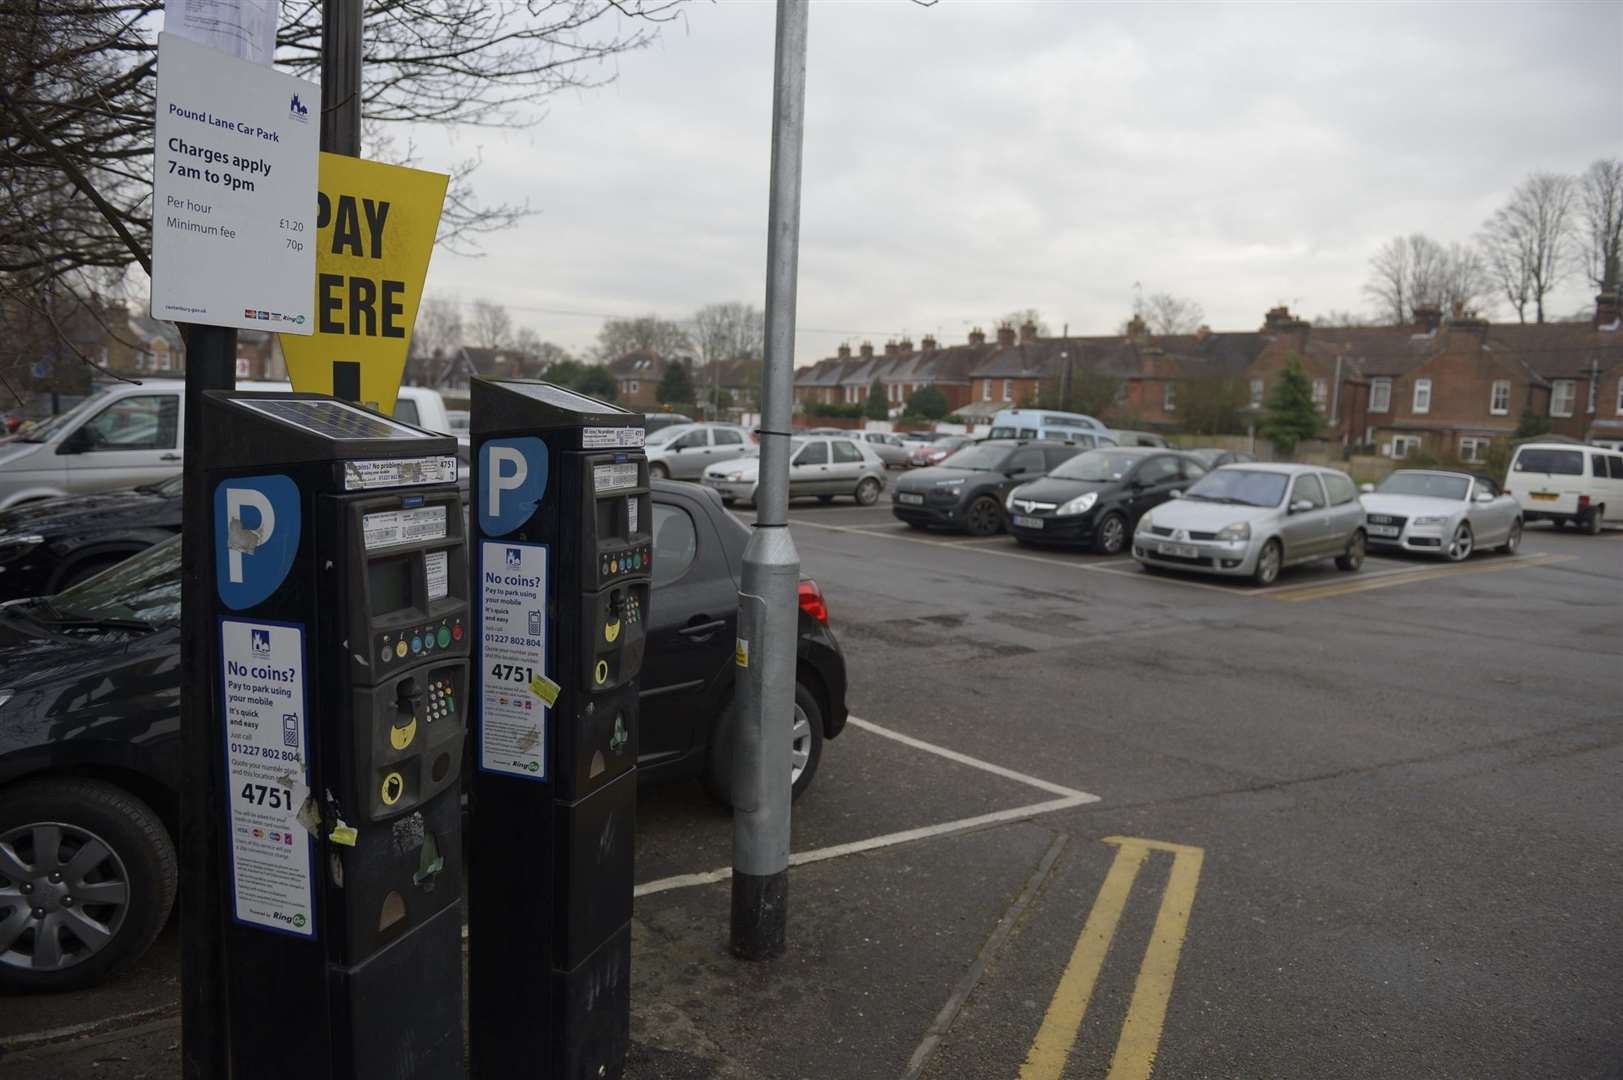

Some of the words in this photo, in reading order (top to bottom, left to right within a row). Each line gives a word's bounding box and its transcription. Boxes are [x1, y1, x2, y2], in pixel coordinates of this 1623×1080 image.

[169, 104, 206, 122] Pound
[208, 114, 235, 130] Lane
[237, 122, 254, 135] Car
[256, 128, 280, 142] Park
[168, 138, 229, 164] Charges
[232, 156, 272, 176] apply
[168, 160, 201, 180] 7am
[205, 169, 220, 184] to
[224, 174, 255, 192] 9pm
[167, 195, 184, 208] Per
[186, 199, 212, 214] hour
[166, 216, 218, 236] Minimum
[220, 225, 236, 238] fee
[280, 218, 304, 232] £1.20
[286, 238, 304, 252] 70p
[319, 273, 405, 338] ERE
[440, 460, 454, 468] 4751
[489, 446, 528, 517] P
[226, 488, 275, 583] P
[486, 572, 501, 584] No
[505, 575, 540, 588] coins?
[520, 590, 536, 599] using
[485, 634, 508, 643] 01227
[510, 636, 525, 645] 802
[526, 639, 541, 647] 804
[228, 661, 247, 676] No
[251, 665, 295, 683] coins?
[492, 664, 532, 683] 4751
[228, 680, 242, 691] Pay
[243, 682, 250, 691] to
[252, 684, 270, 695] park
[270, 687, 292, 698] using
[228, 694, 246, 703] your
[248, 694, 273, 707] mobile
[230, 718, 242, 727] and
[244, 722, 259, 730] easy
[240, 710, 259, 719] quick
[231, 743, 260, 756] 01227
[262, 748, 280, 759] 802
[282, 751, 299, 762] 804
[242, 784, 292, 811] 4751
